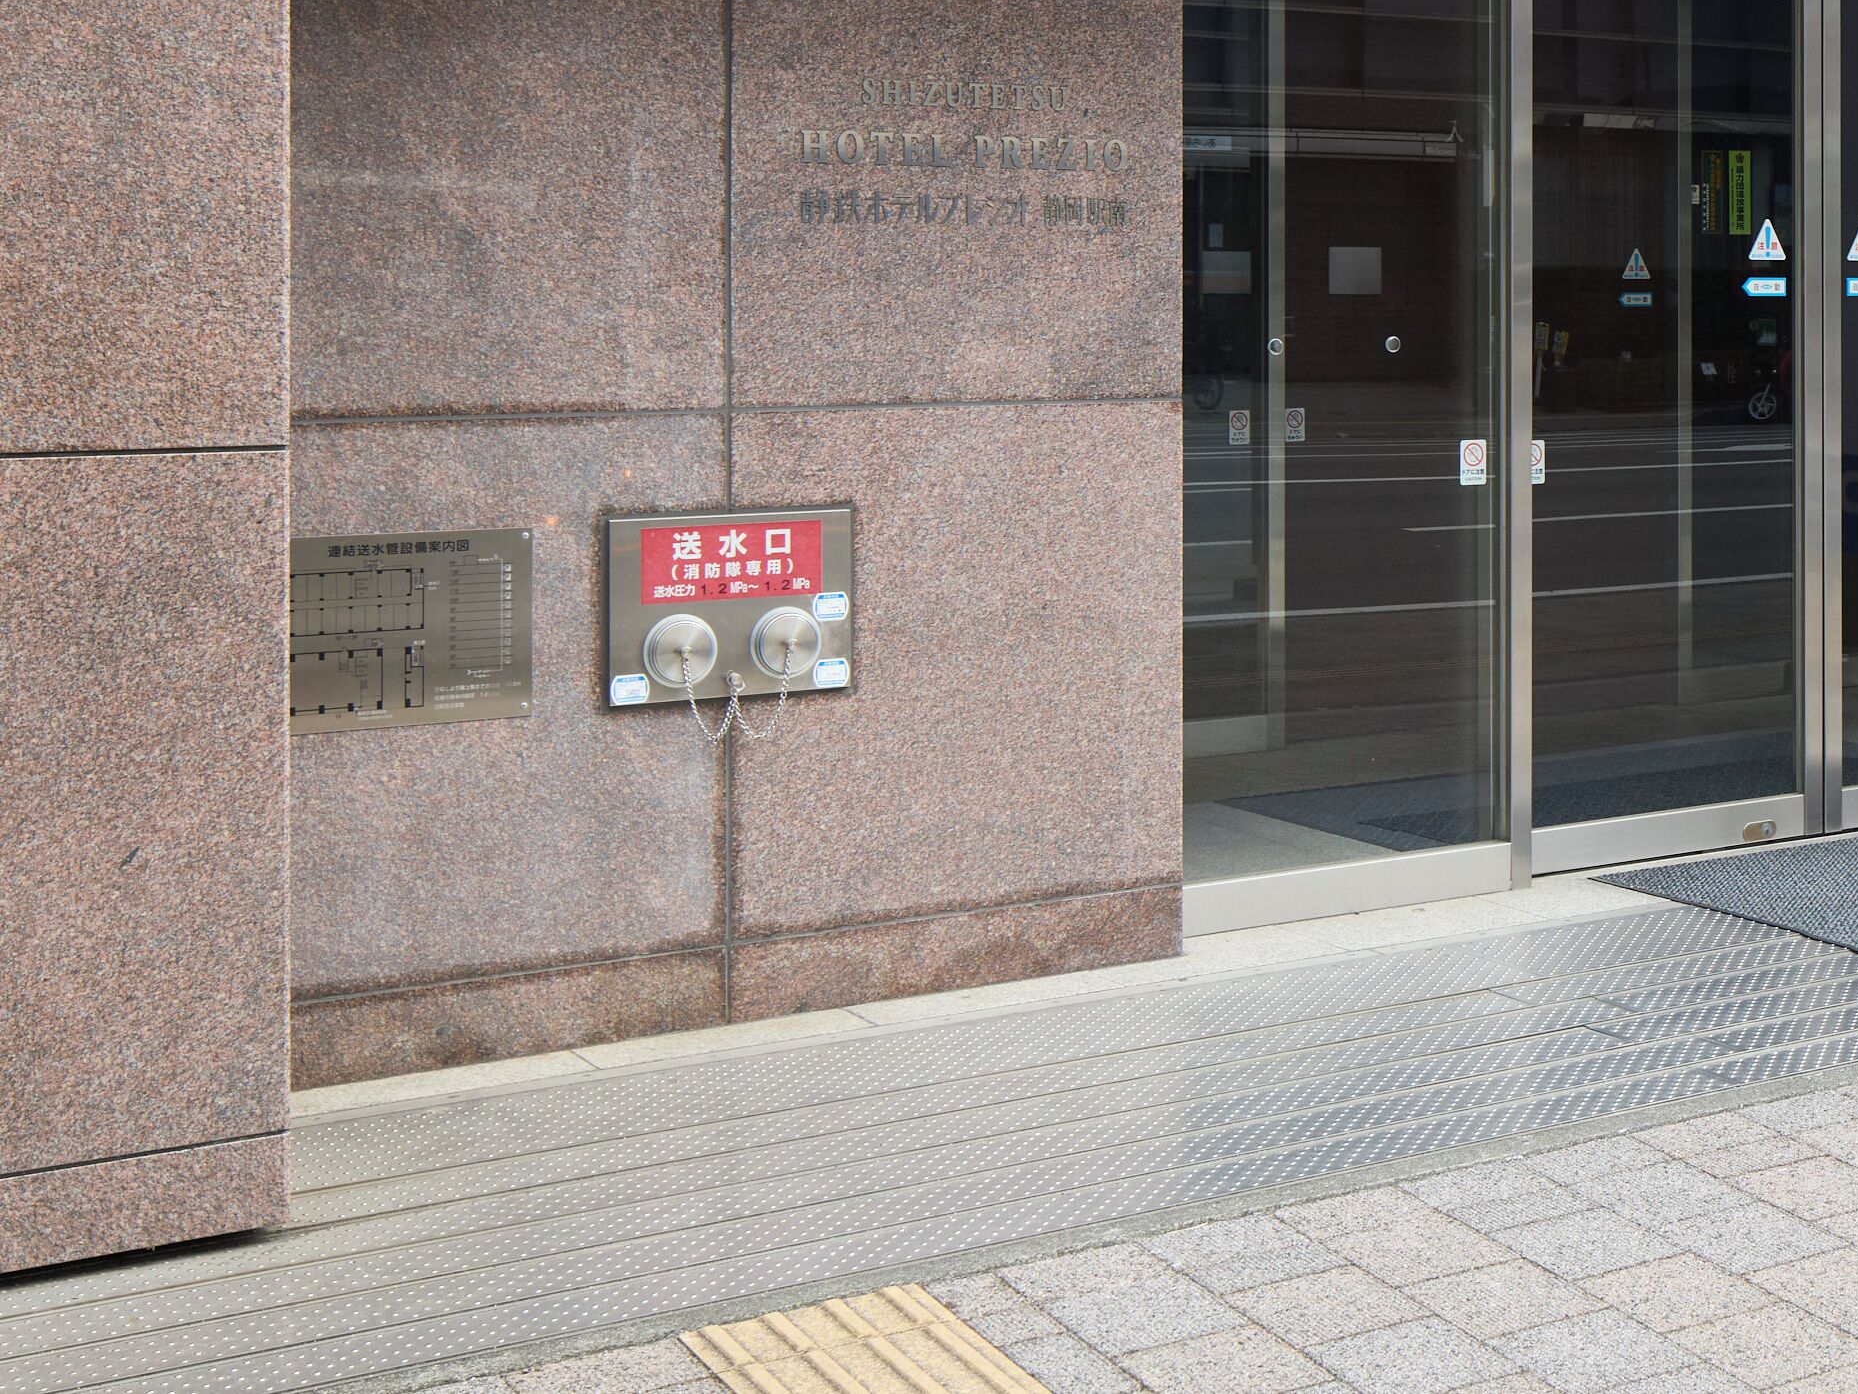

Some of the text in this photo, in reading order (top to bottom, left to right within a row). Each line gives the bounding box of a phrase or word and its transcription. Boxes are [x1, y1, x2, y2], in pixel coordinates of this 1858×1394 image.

[862, 78, 1069, 112] SHIZUTETSU
[801, 130, 1129, 172] HOTEL PREZIO
[801, 190, 1027, 226] 静鉄ホテルプレジオ
[328, 539, 470, 558] 連結送水管設備案内図
[672, 528, 792, 561] 送水口
[653, 583, 696, 598] 送水圧力
[792, 577, 811, 590] MPa
